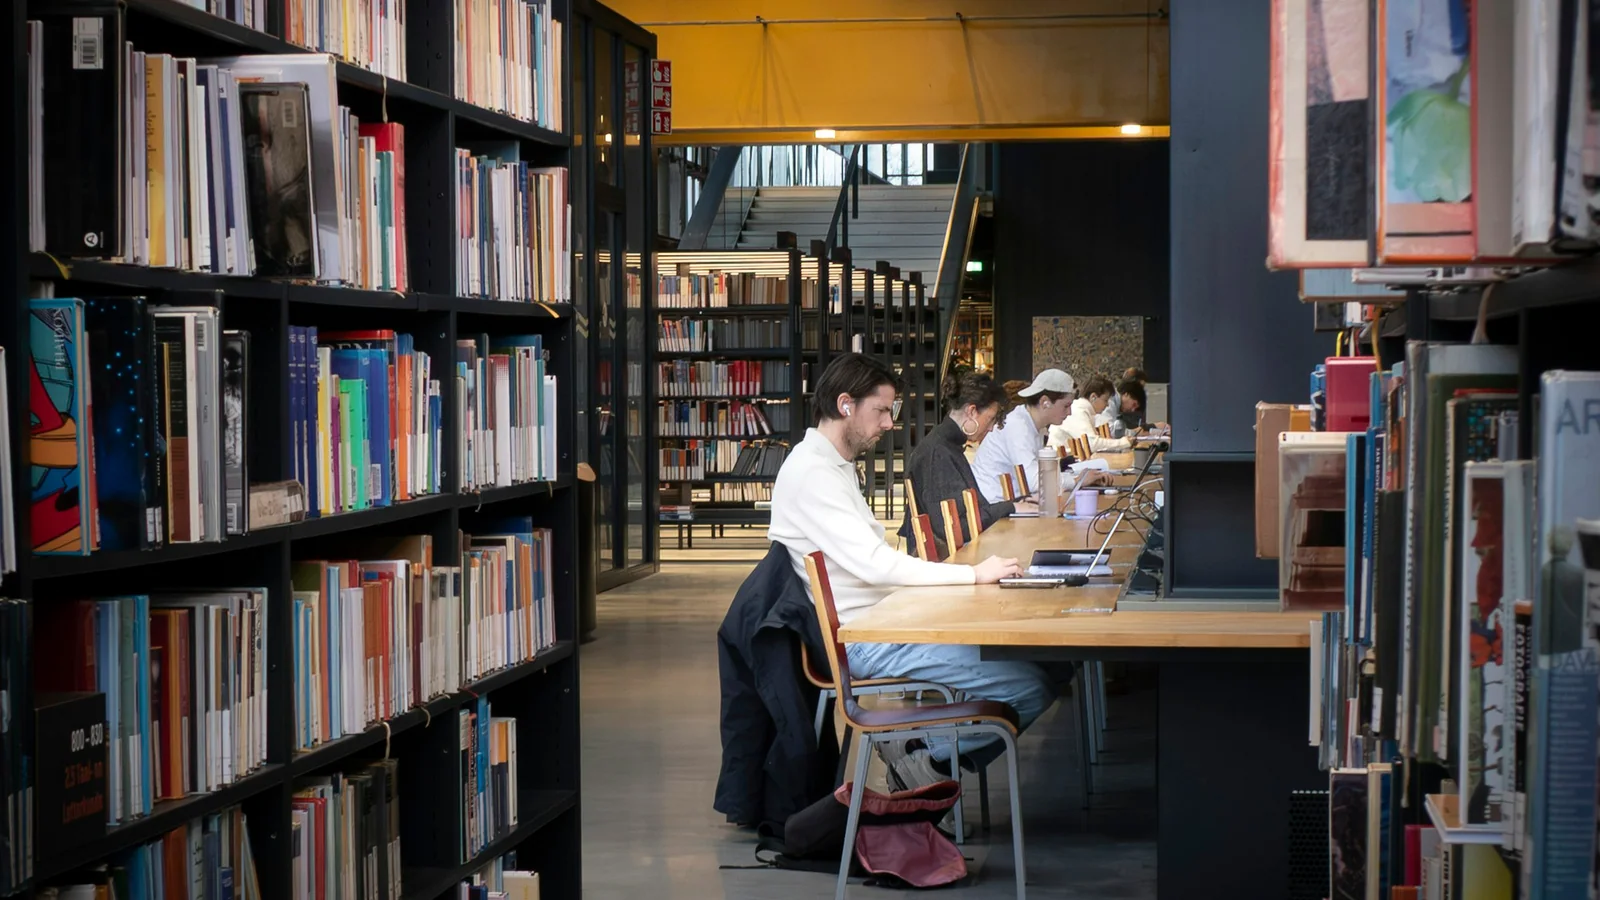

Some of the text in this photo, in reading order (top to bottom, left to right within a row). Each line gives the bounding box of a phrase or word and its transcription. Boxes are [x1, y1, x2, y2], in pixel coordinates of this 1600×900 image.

[54, 308, 65, 369] PHAIDON
[1515, 623, 1526, 732] FOTOGRAFIE
[71, 728, 84, 752] 800
[91, 723, 103, 746] 830
